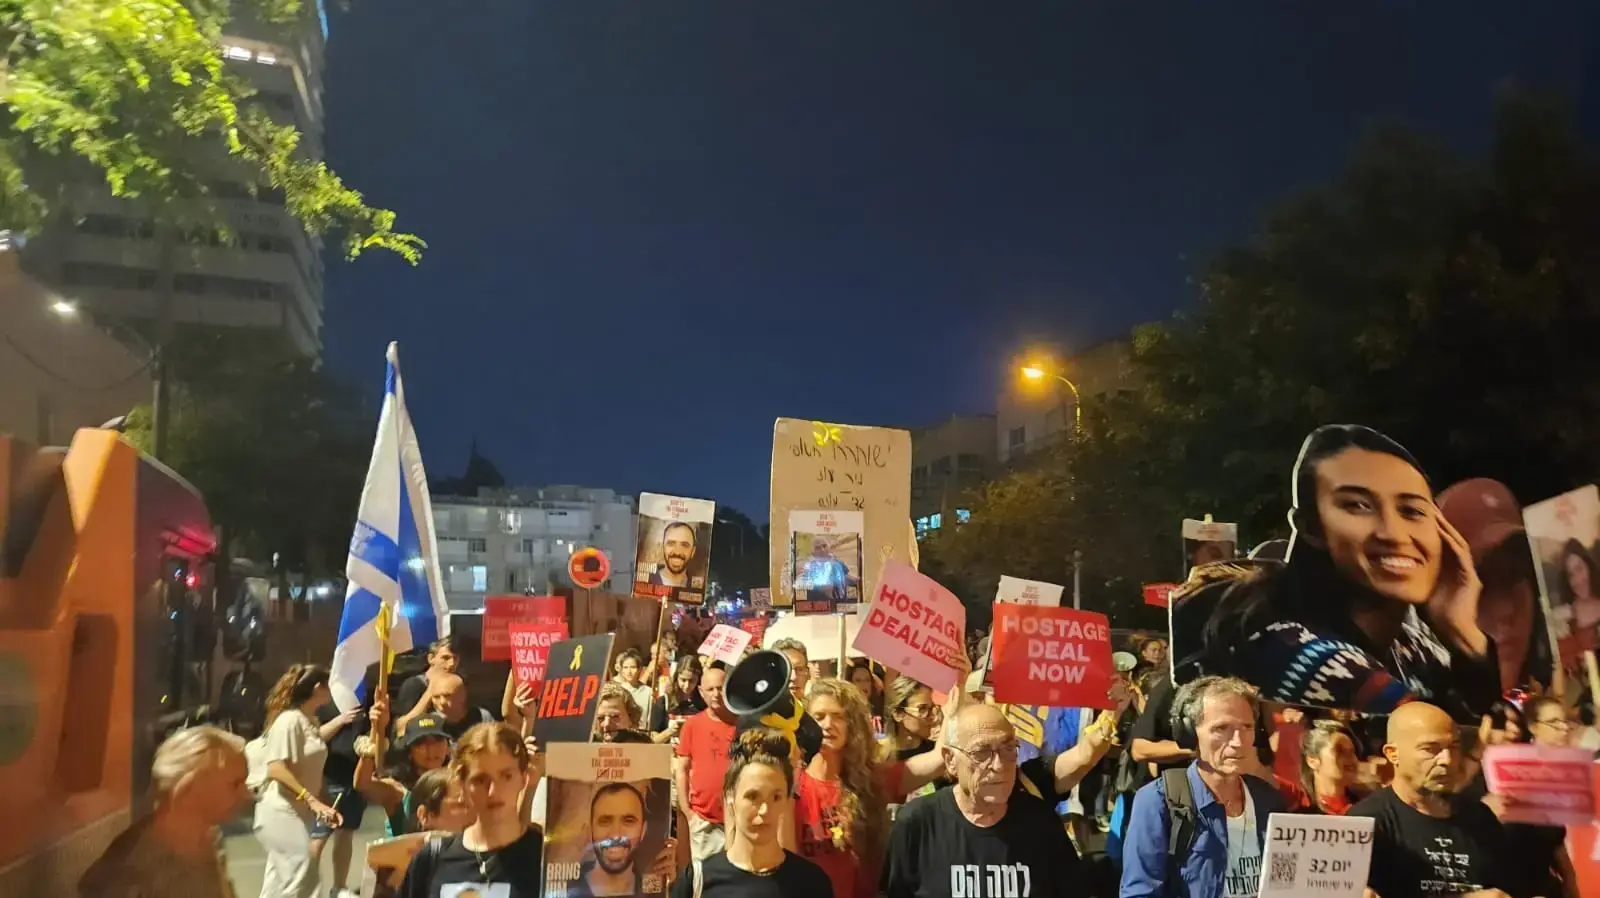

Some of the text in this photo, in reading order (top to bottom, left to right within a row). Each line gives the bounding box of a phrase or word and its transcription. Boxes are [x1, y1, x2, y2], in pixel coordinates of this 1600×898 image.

[868, 608, 921, 649] DEAL
[1002, 615, 1109, 642] HOSTAGE
[1028, 638, 1091, 662] DEAL
[1028, 662, 1087, 684] NOW
[537, 674, 600, 718] HELP
[546, 862, 581, 881] BRING
[1308, 858, 1352, 873] יום 32
[950, 861, 1031, 898] למה הם
